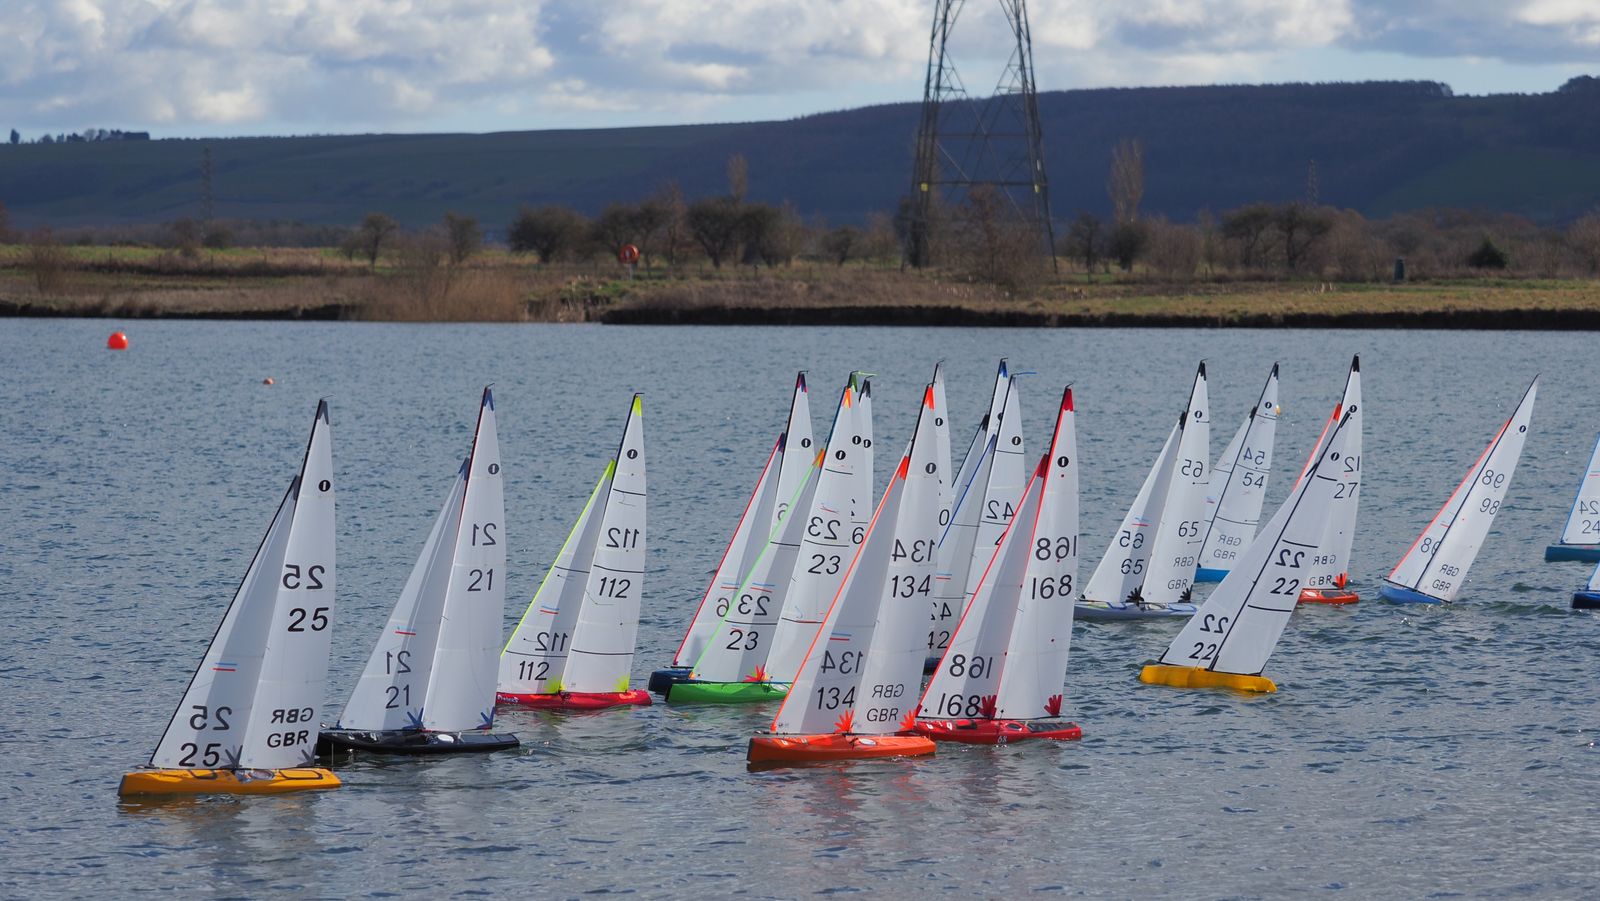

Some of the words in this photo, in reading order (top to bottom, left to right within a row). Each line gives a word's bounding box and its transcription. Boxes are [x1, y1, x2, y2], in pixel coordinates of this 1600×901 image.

[1243, 472, 1264, 488] 54
[1480, 498, 1500, 516] 98
[1179, 521, 1198, 537] 65
[808, 554, 840, 574] 23
[1214, 549, 1236, 560] GBR
[1121, 559, 1144, 574] 65
[468, 569, 493, 591] 21
[600, 577, 630, 598] 112
[892, 575, 930, 598] 134
[1032, 575, 1071, 599] 168
[1168, 579, 1187, 590] GBR
[1270, 578, 1299, 595] 22
[1310, 575, 1332, 586] GBR
[1432, 579, 1451, 592] GBR
[288, 607, 329, 632] 25
[727, 630, 758, 650] 23
[1189, 642, 1217, 661] 22
[520, 661, 549, 680] 112
[386, 685, 409, 709] 21
[818, 687, 855, 709] 134
[938, 693, 980, 716] 168
[867, 708, 898, 721] GBR
[267, 730, 308, 747] GBR
[179, 743, 220, 767] 25
